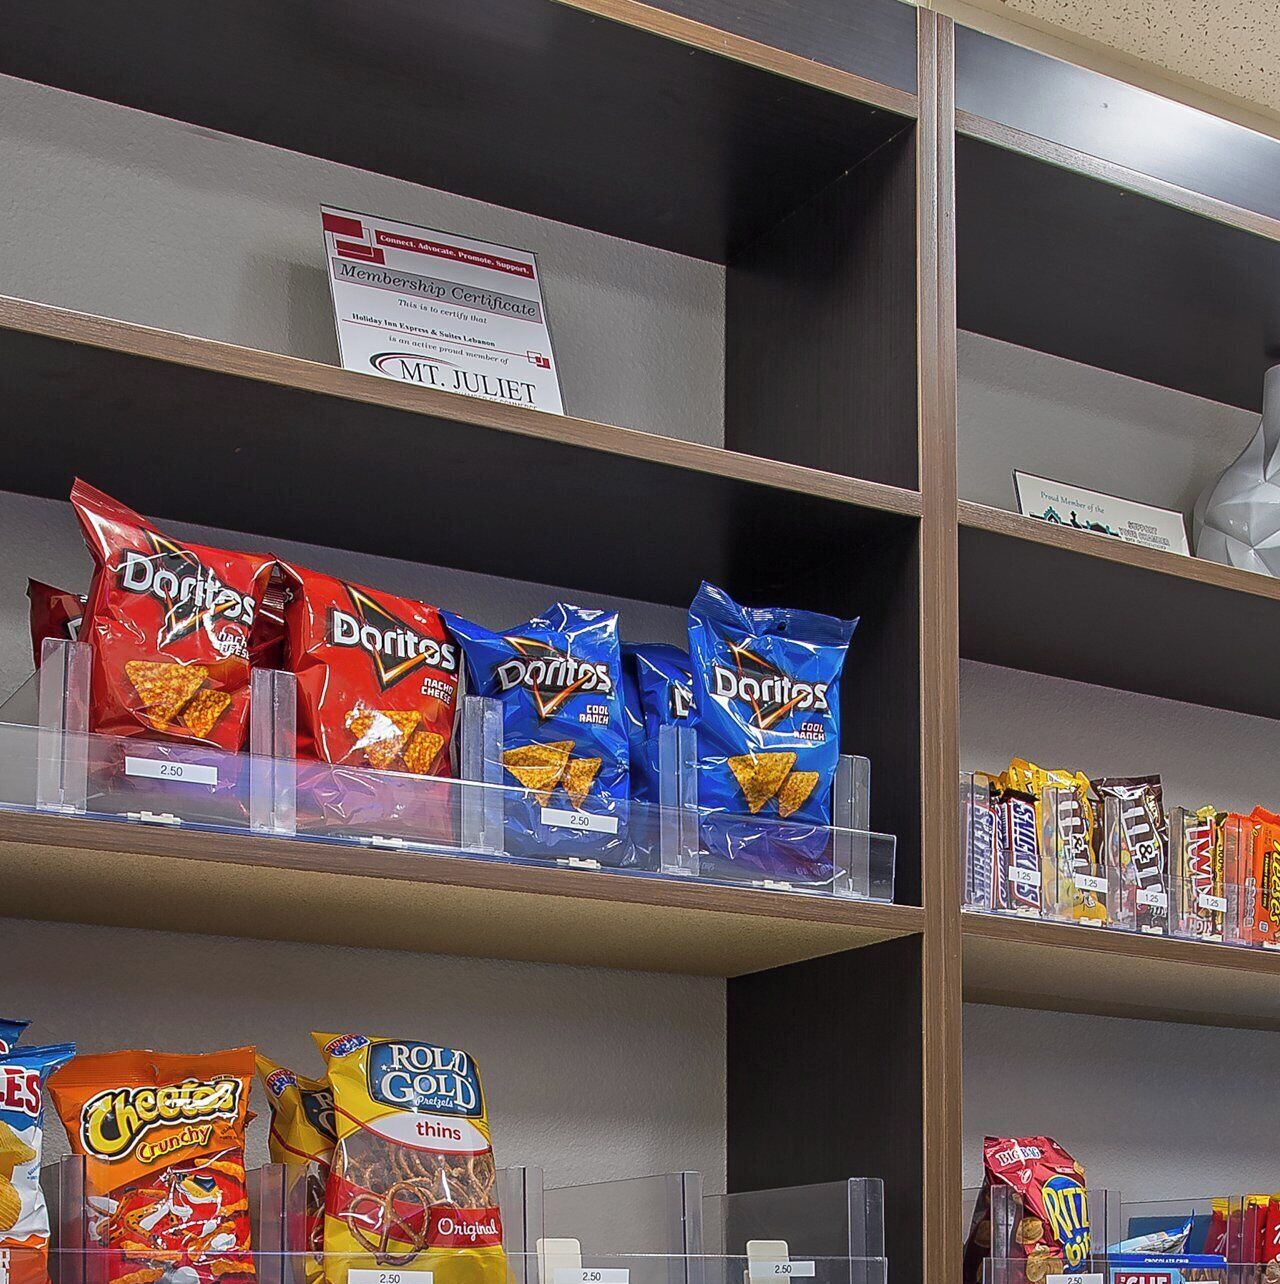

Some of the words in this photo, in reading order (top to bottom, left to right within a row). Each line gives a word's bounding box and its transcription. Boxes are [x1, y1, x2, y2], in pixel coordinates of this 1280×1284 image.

[380, 235, 416, 248] Connect.
[418, 243, 457, 257] Advocate.
[458, 251, 494, 266] Promote.
[496, 260, 530, 274] Support.
[340, 264, 446, 297] Membership
[451, 288, 536, 317] Certificate
[397, 299, 418, 310] This
[420, 303, 428, 311] is
[430, 305, 438, 313] to
[440, 309, 469, 322] certify
[470, 314, 487, 324] that
[352, 313, 383, 326] Holiday
[384, 319, 398, 328] Inn
[399, 322, 429, 336] Express
[431, 328, 438, 336] &
[439, 330, 462, 341] Suites
[463, 334, 496, 347] Lebanon
[389, 335, 397, 343] is
[399, 338, 410, 346] an
[411, 340, 437, 351] active
[439, 346, 464, 357] proud
[465, 351, 498, 362] member
[499, 357, 509, 366] of
[399, 359, 446, 387] MT.
[452, 369, 537, 404] JULIET
[1041, 491, 1059, 502] Proud
[1060, 497, 1086, 509] Member
[122, 550, 256, 625] Doritos
[332, 610, 457, 671] Doritos
[497, 657, 611, 694] Doritos
[421, 686, 452, 705] CHEESE
[423, 677, 455, 696] NACHO
[714, 664, 829, 711] Doritos
[587, 704, 609, 715] COOL
[579, 714, 609, 726] RANCH
[800, 722, 825, 733] COOL
[160, 764, 183, 778] 2.50
[570, 814, 590, 827] 2.50
[1017, 871, 1032, 881] 1.25
[1084, 878, 1098, 888] 1.25
[1145, 894, 1159, 903] 1.25
[1205, 898, 1219, 908] 1.25
[388, 1044, 469, 1077] ROLD
[380, 1071, 477, 1110] GOLD
[416, 1095, 454, 1108] Pretzels
[87, 1078, 237, 1154] Cheetos
[416, 1121, 461, 1140] thins
[136, 1124, 214, 1164] Crunchy
[995, 1152, 1019, 1166] BIG
[1020, 1147, 1041, 1161] BAG
[1041, 1186, 1091, 1241] RITZ
[437, 1217, 498, 1241] Original
[581, 1271, 602, 1283] 2.50
[774, 1263, 792, 1275] 2.50
[379, 1274, 401, 1284] 2.50
